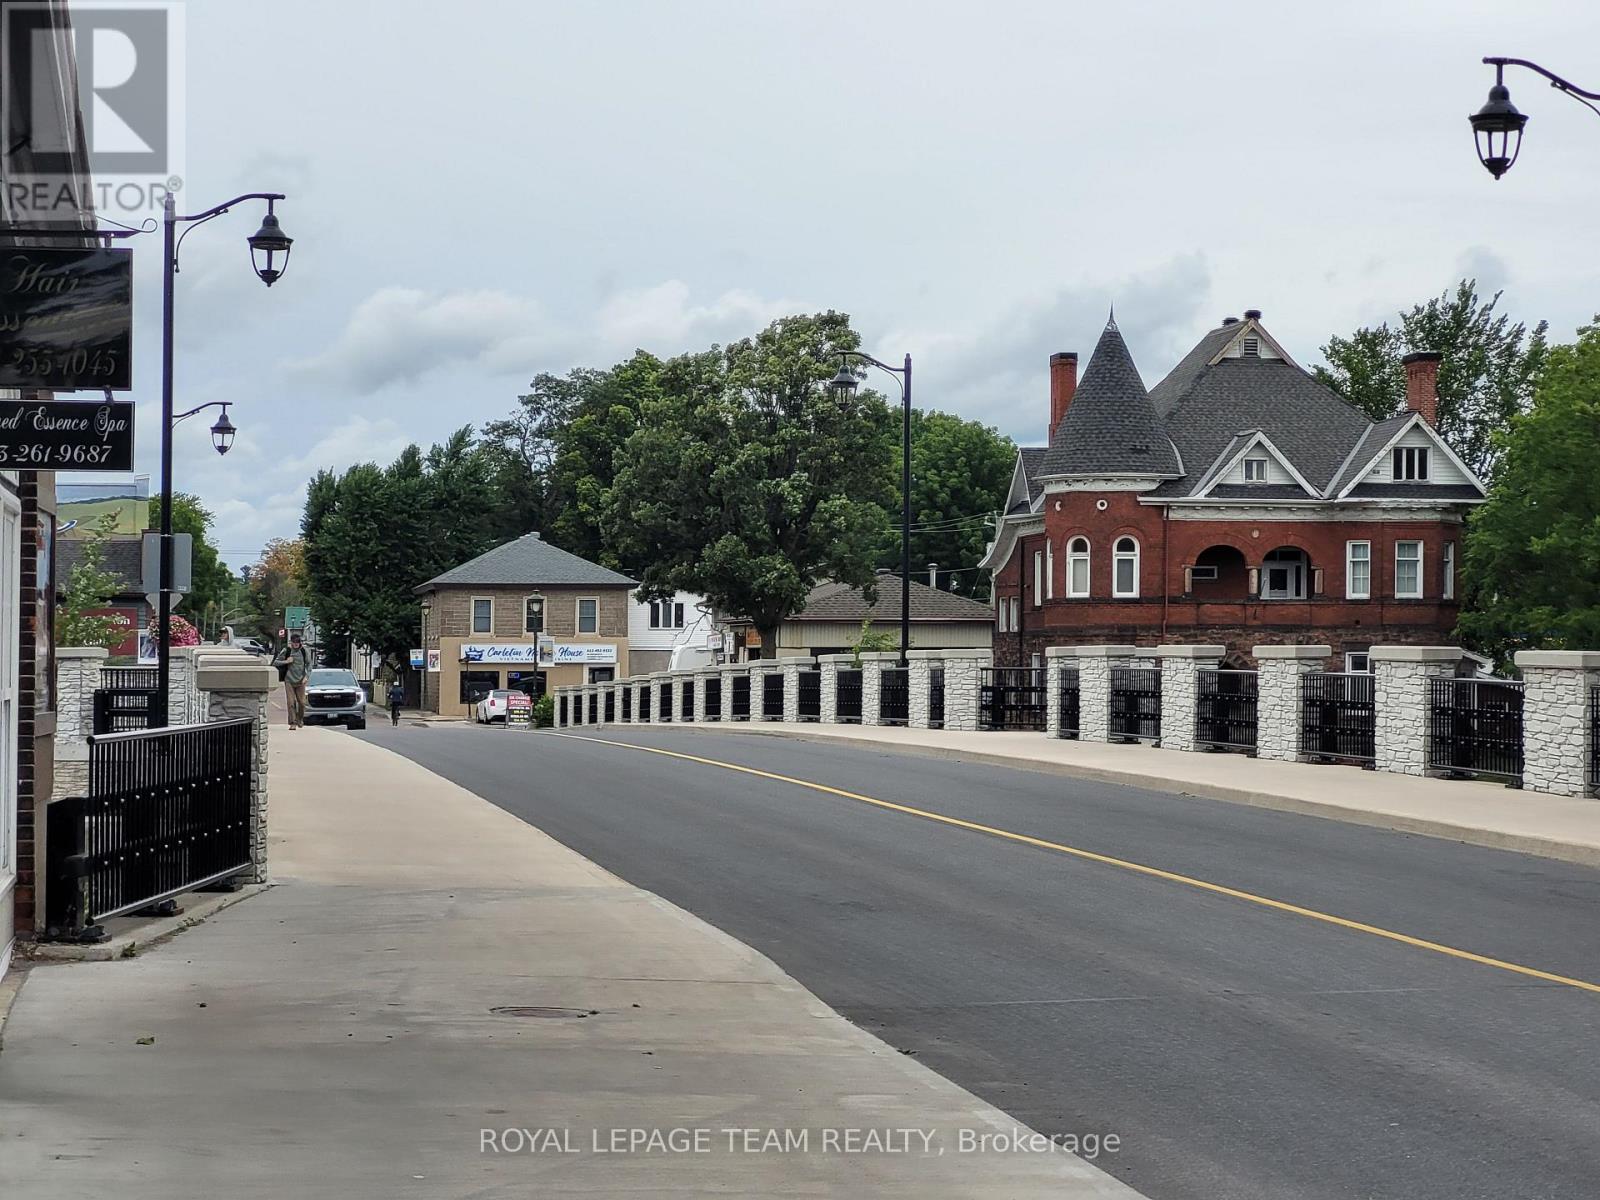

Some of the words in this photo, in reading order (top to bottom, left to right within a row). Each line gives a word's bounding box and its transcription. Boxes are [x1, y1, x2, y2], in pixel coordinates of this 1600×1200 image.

[8, 255, 79, 293] Hair
[26, 406, 88, 431] Essence
[94, 406, 128, 441] Spa
[487, 646, 522, 657] Carleton
[558, 646, 584, 657] House
